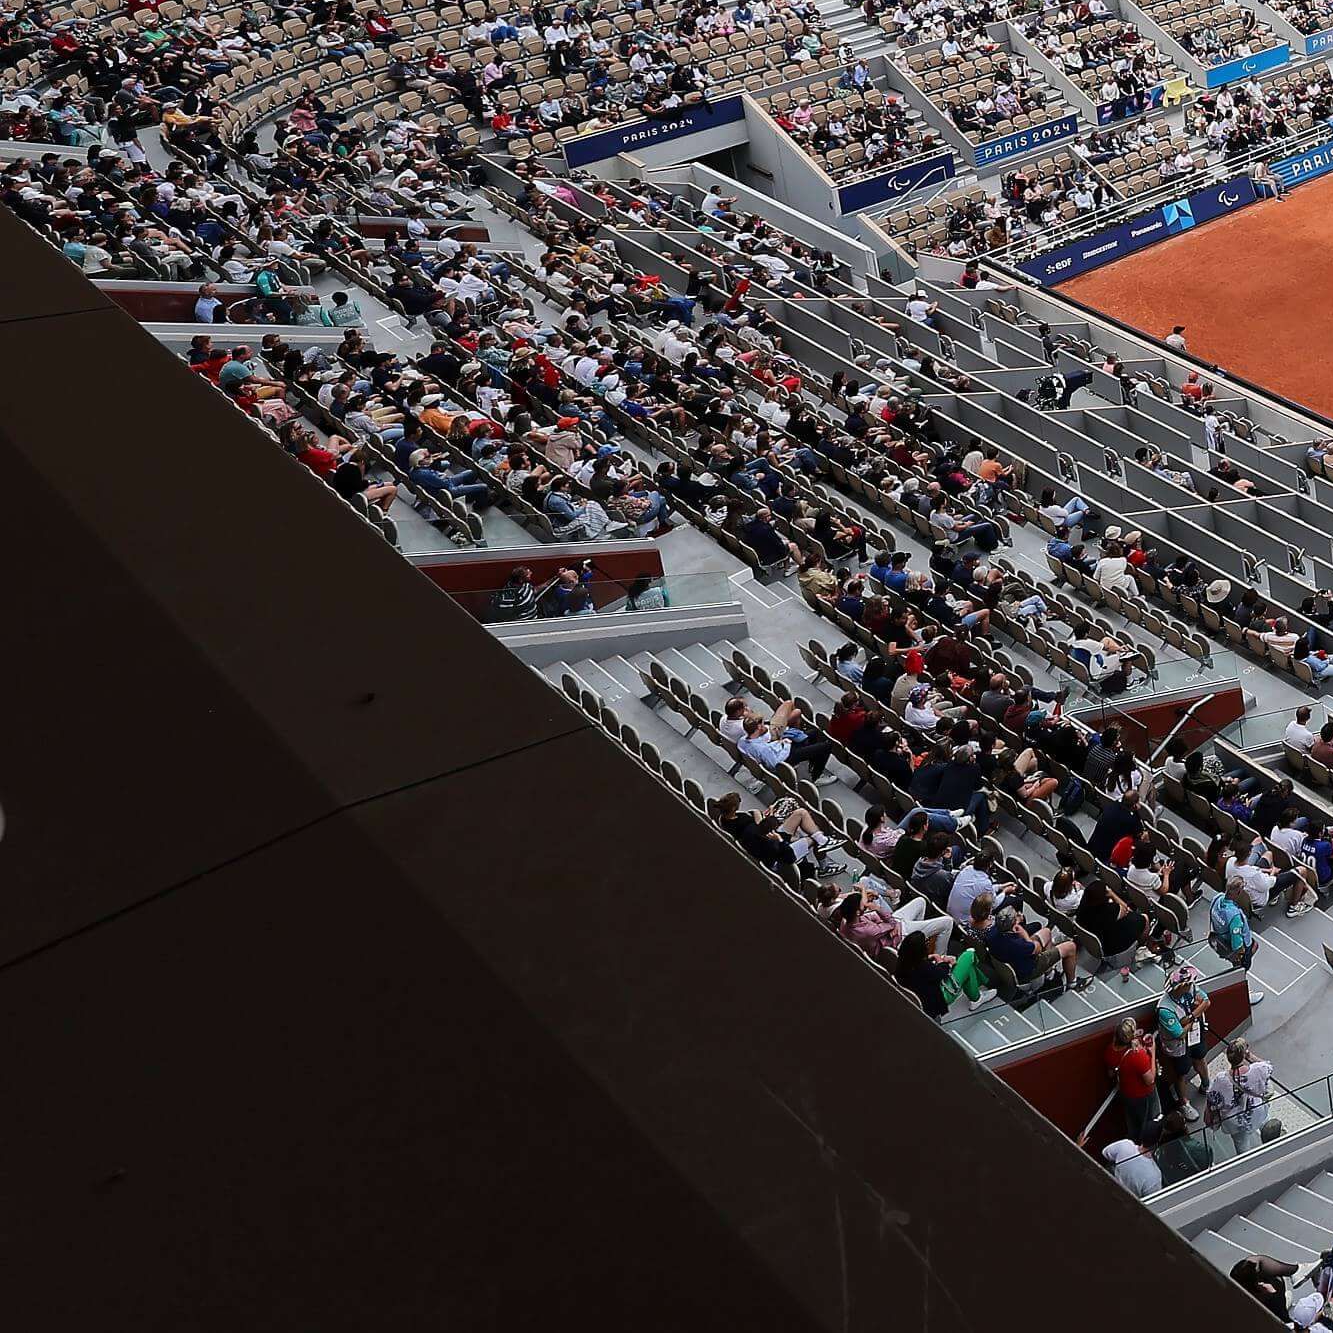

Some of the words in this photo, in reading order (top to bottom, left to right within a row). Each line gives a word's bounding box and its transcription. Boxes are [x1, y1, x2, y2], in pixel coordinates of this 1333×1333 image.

[623, 127, 658, 144] PARIS
[661, 118, 694, 133] 2024
[984, 136, 1028, 159] PARIS
[1032, 123, 1070, 143] 2024
[1082, 240, 1118, 260] BRIDGESTONE
[1130, 220, 1163, 238] Panasonic
